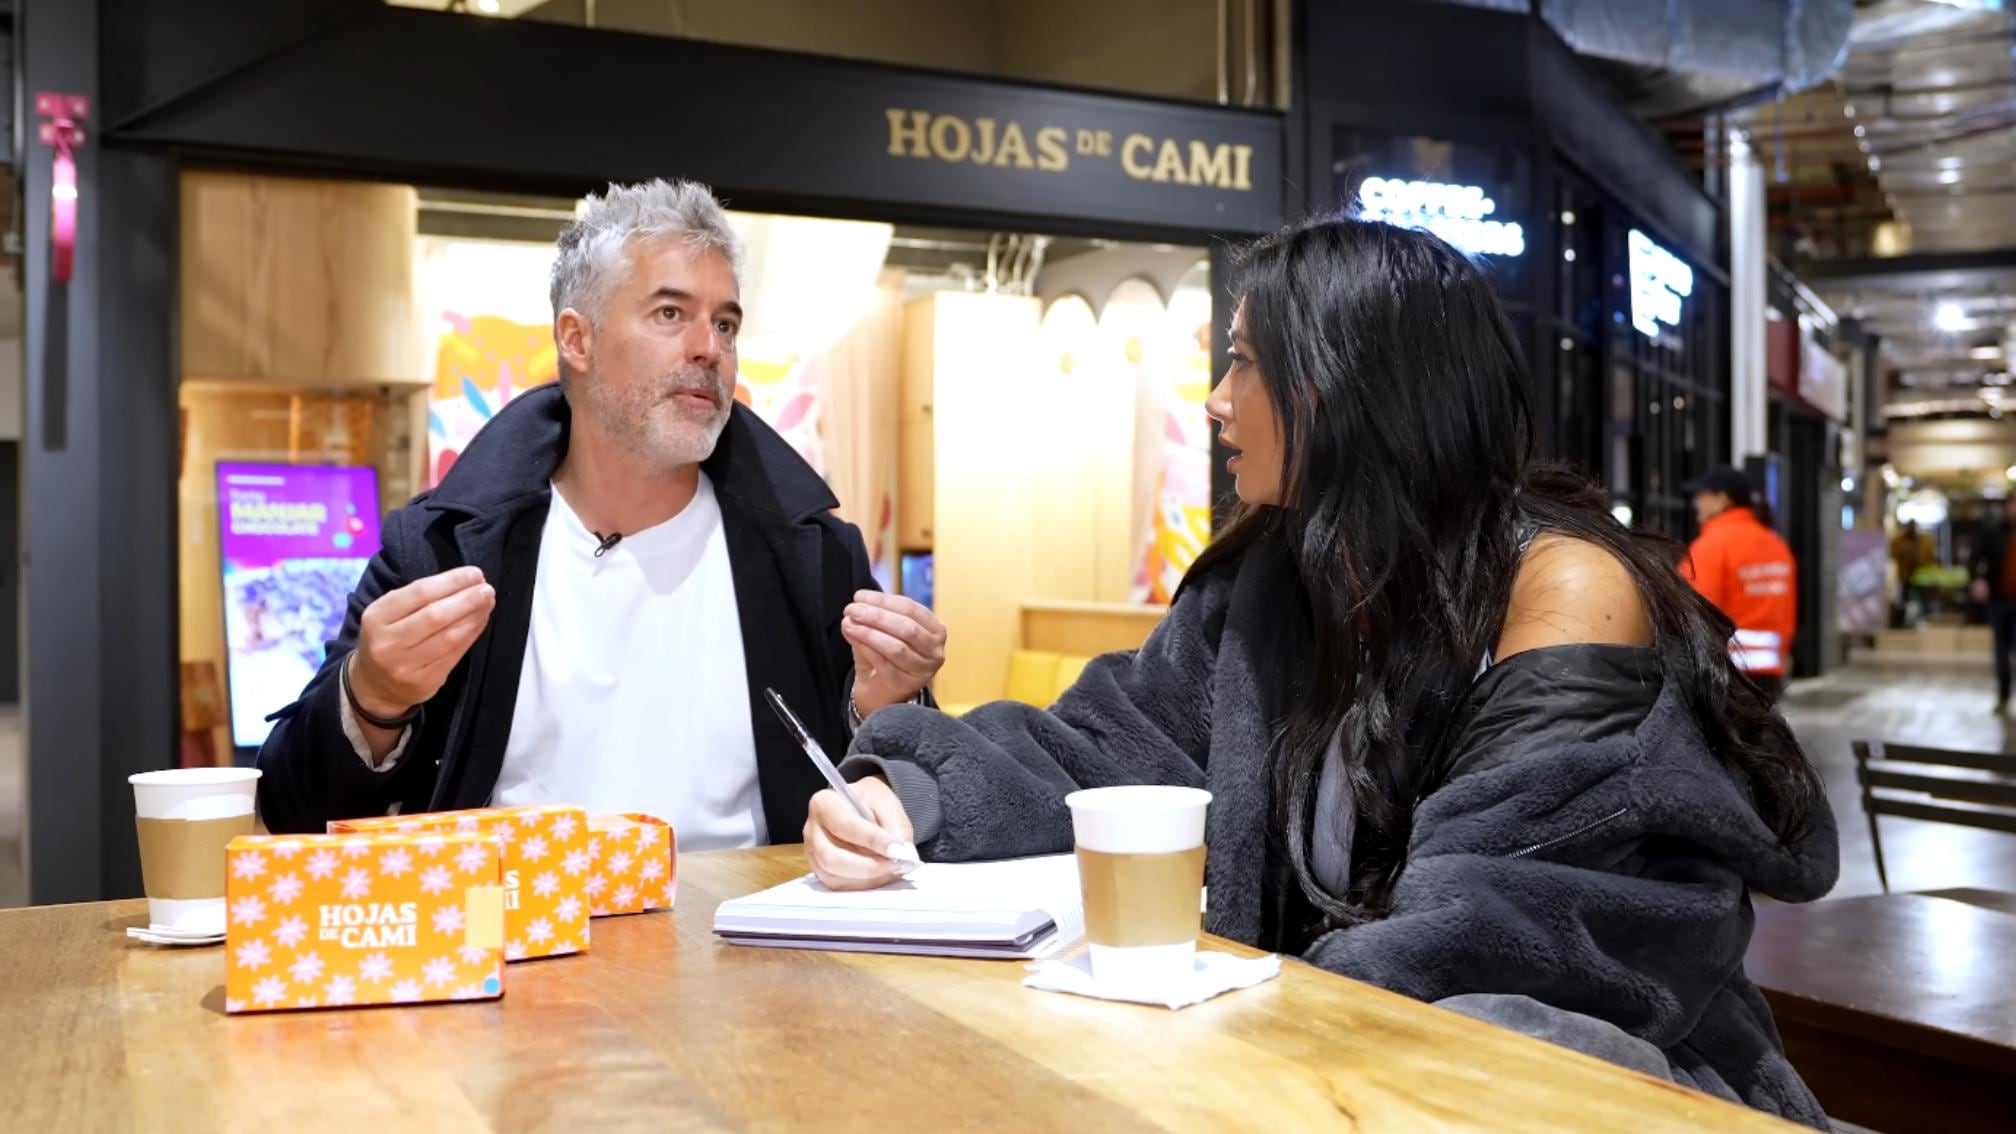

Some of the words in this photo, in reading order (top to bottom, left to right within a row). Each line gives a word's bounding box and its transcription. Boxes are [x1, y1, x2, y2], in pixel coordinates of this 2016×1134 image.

[886, 109, 1069, 172] HOJAS
[1076, 129, 1113, 157] DE
[1121, 133, 1253, 190] CAMI
[230, 502, 328, 523] MANJAR
[319, 902, 417, 927] HOJAS
[319, 928, 338, 940] DE
[340, 924, 417, 948] CAMI
